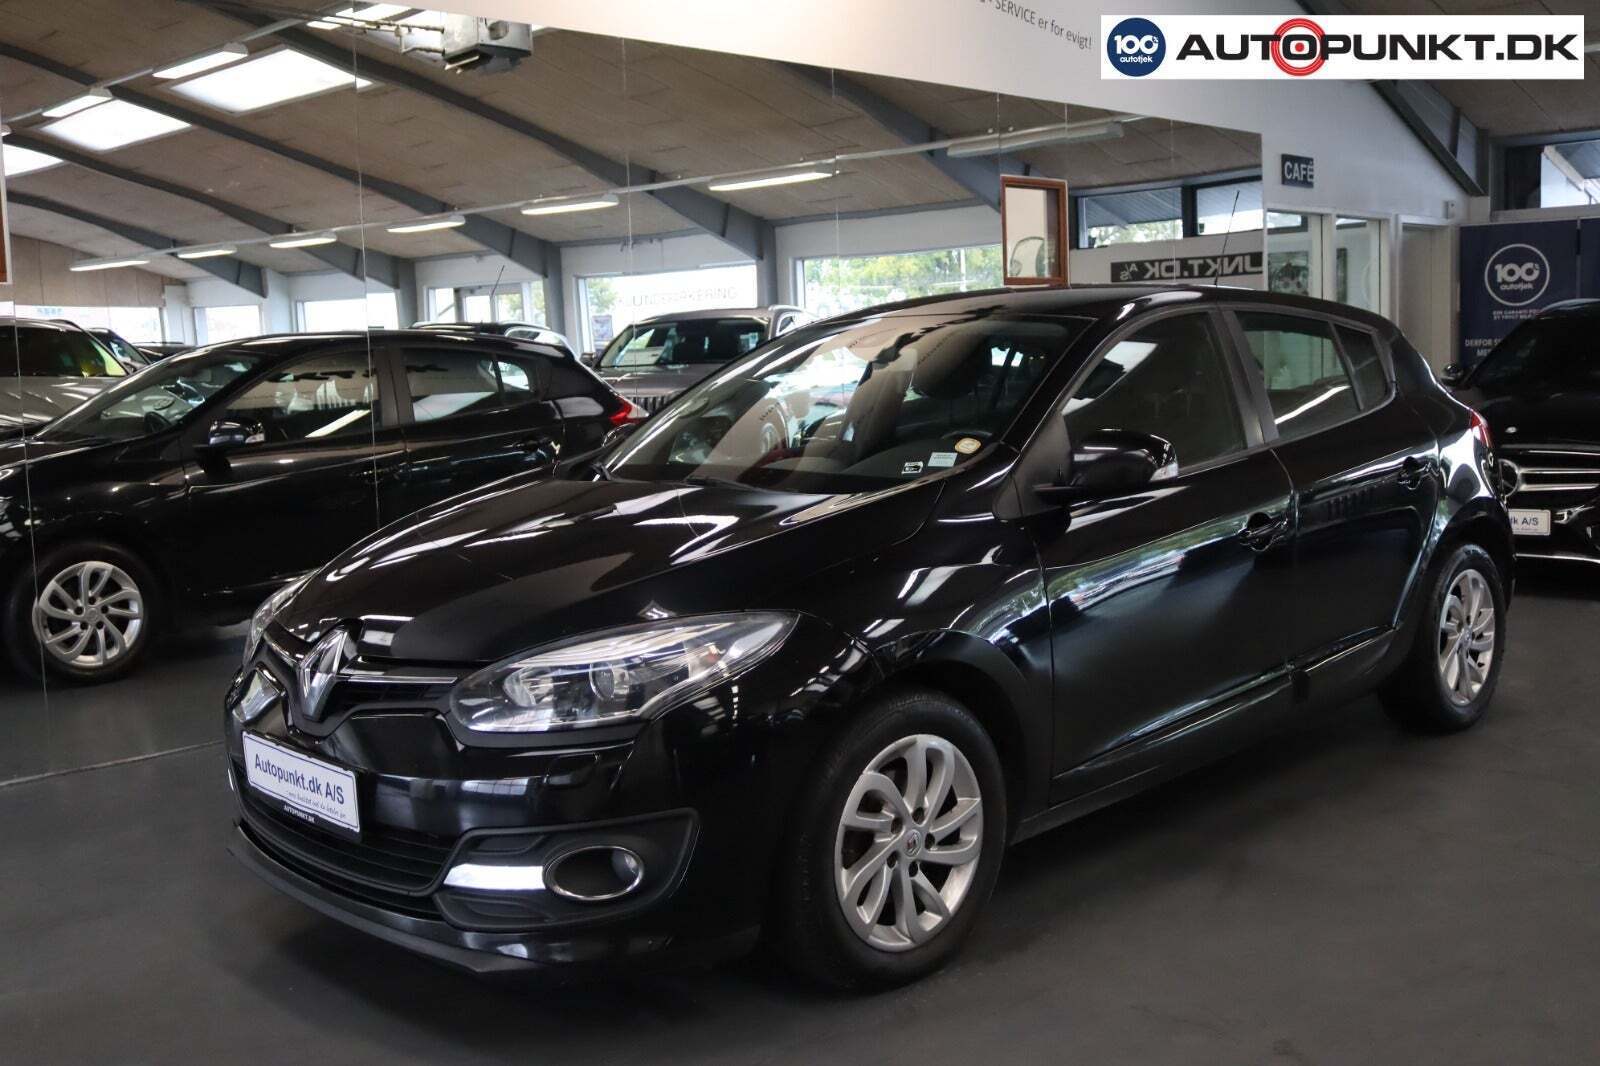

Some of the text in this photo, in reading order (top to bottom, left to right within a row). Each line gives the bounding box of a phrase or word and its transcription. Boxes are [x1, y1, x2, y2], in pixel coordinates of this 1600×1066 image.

[995, 0, 1092, 50] SERVICE er for evigt!
[254, 753, 323, 796] Autopunkt.dk
[325, 781, 345, 805] A/S
